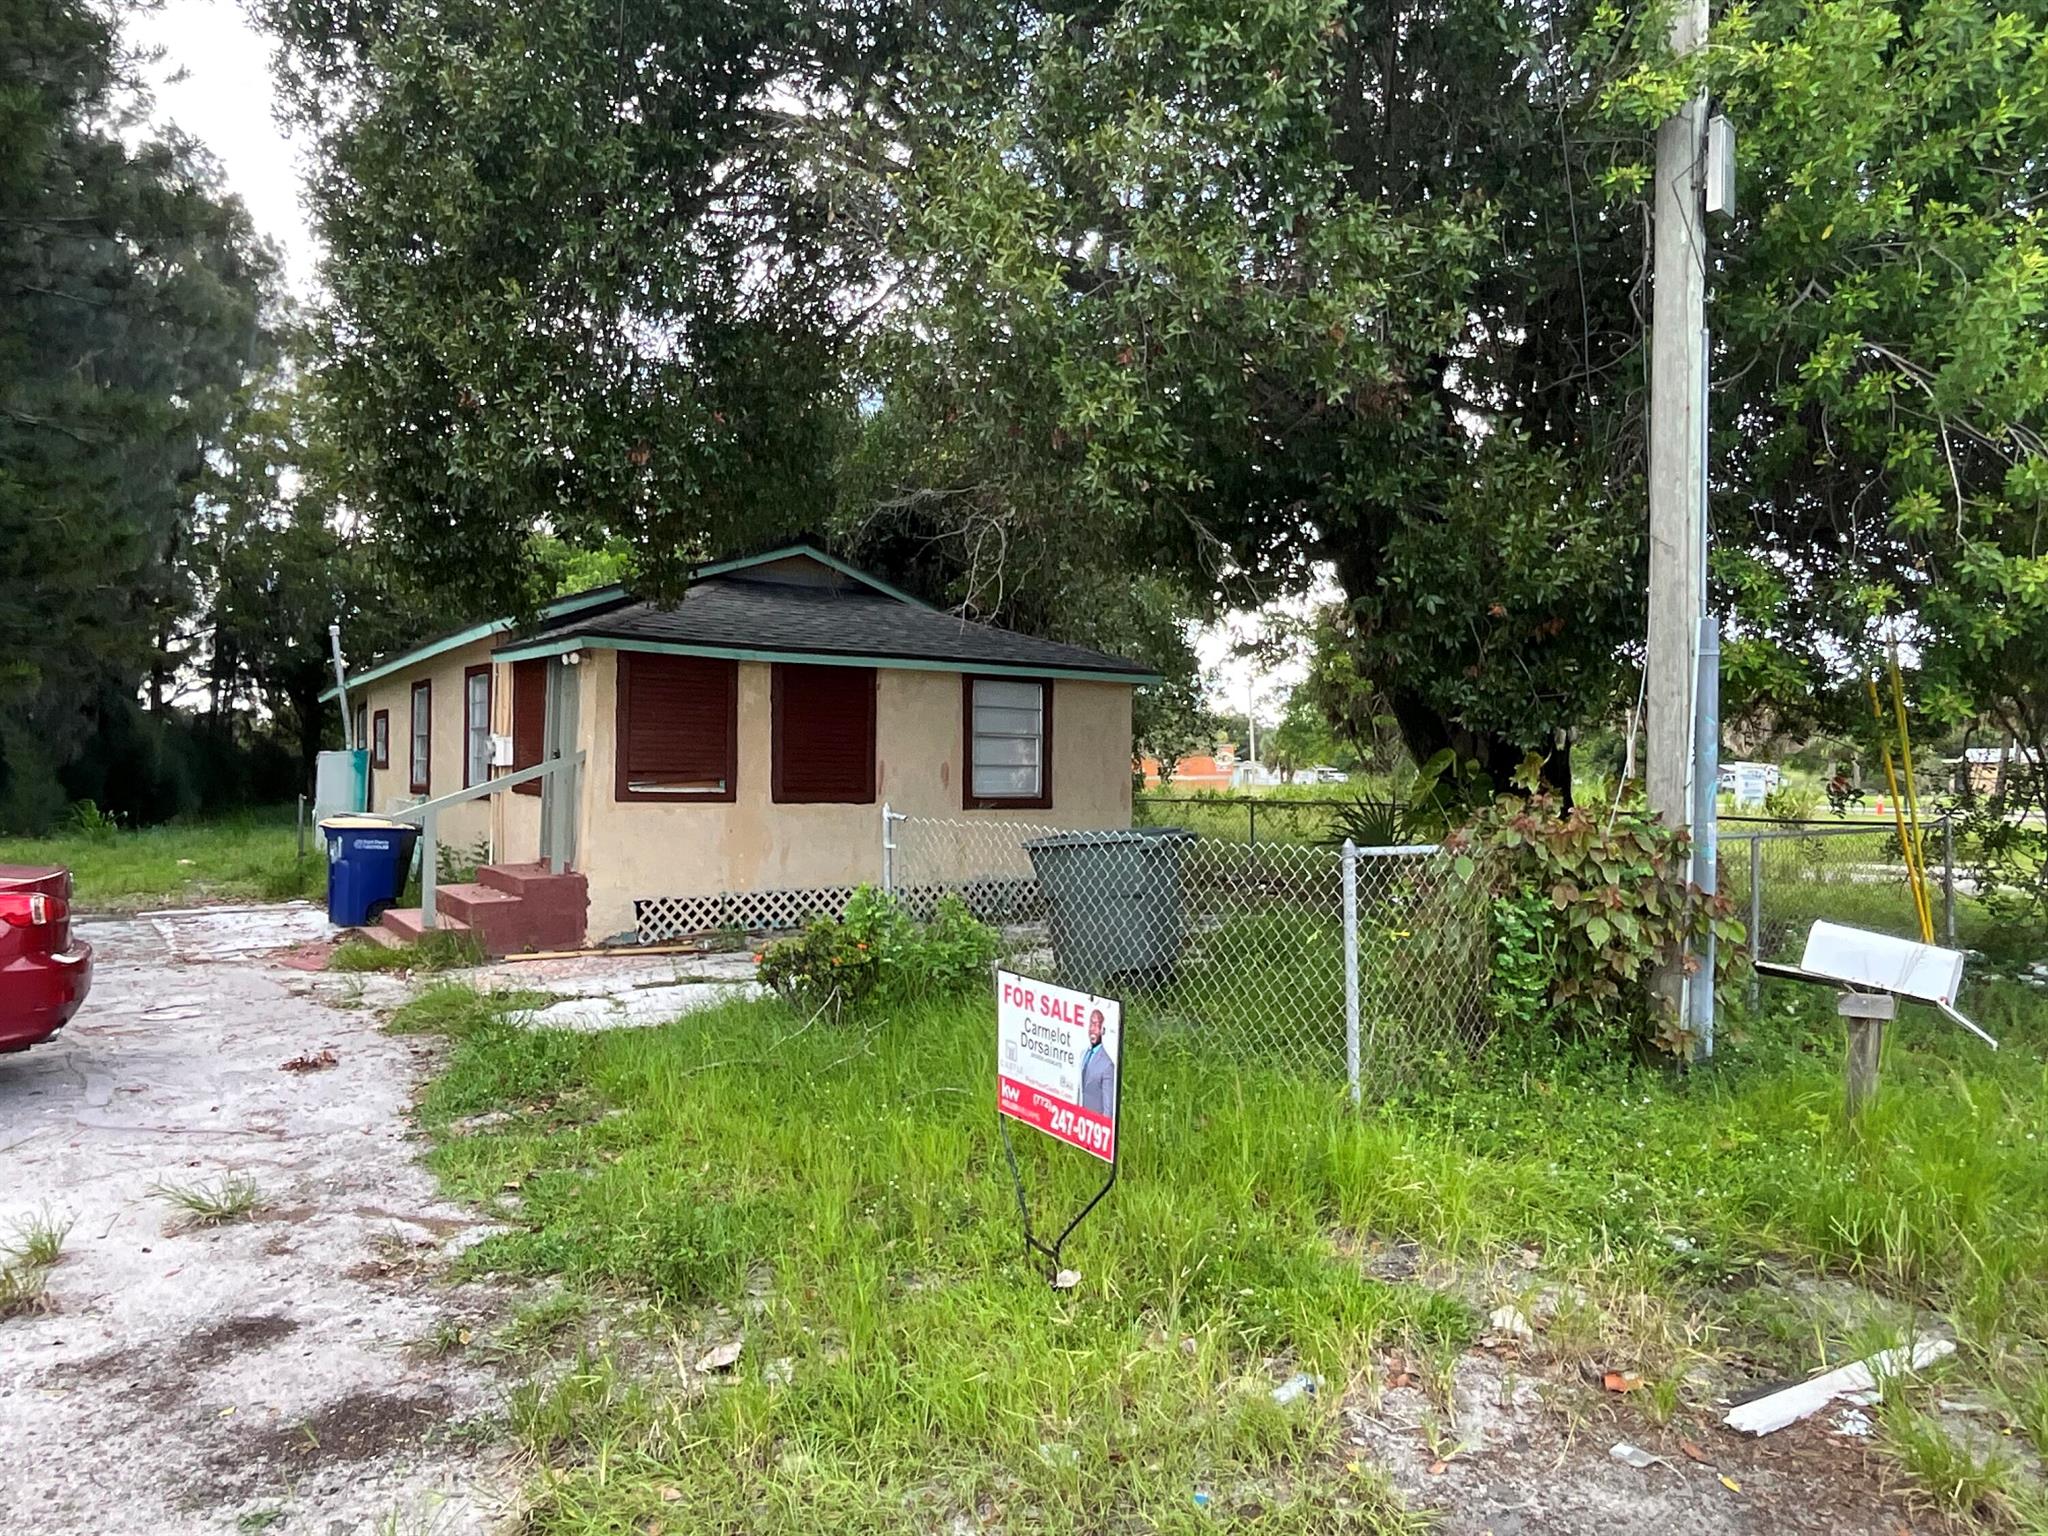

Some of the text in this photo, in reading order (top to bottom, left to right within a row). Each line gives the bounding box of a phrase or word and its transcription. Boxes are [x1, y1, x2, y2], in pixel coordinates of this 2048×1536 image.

[1004, 984, 1085, 1027] FOR SALE
[1024, 1017, 1071, 1047] Carmelot
[1050, 1104, 1111, 1152] 247-0797
